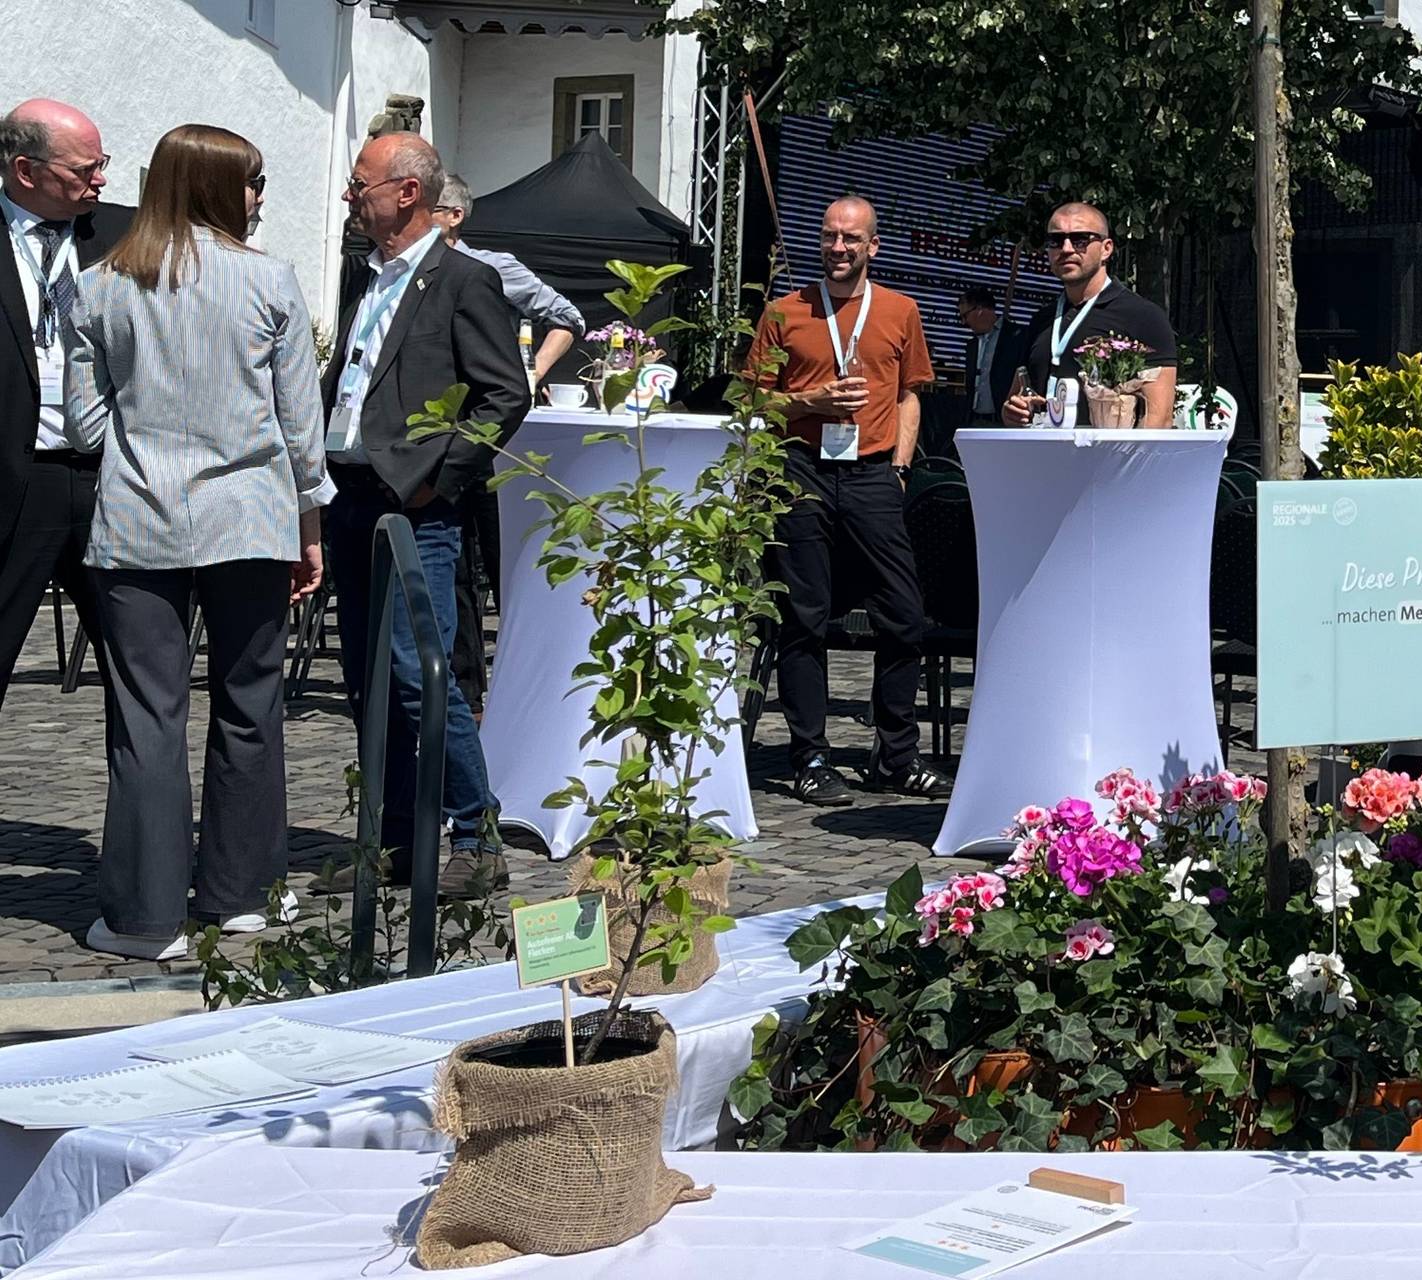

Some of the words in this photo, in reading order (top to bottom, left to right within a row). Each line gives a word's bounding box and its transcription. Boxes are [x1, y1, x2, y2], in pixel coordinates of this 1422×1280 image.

[1272, 503, 1328, 515] REGIONALE
[1272, 515, 1296, 526] 2025
[1341, 561, 1396, 593] Diese
[1337, 606, 1396, 624] machen
